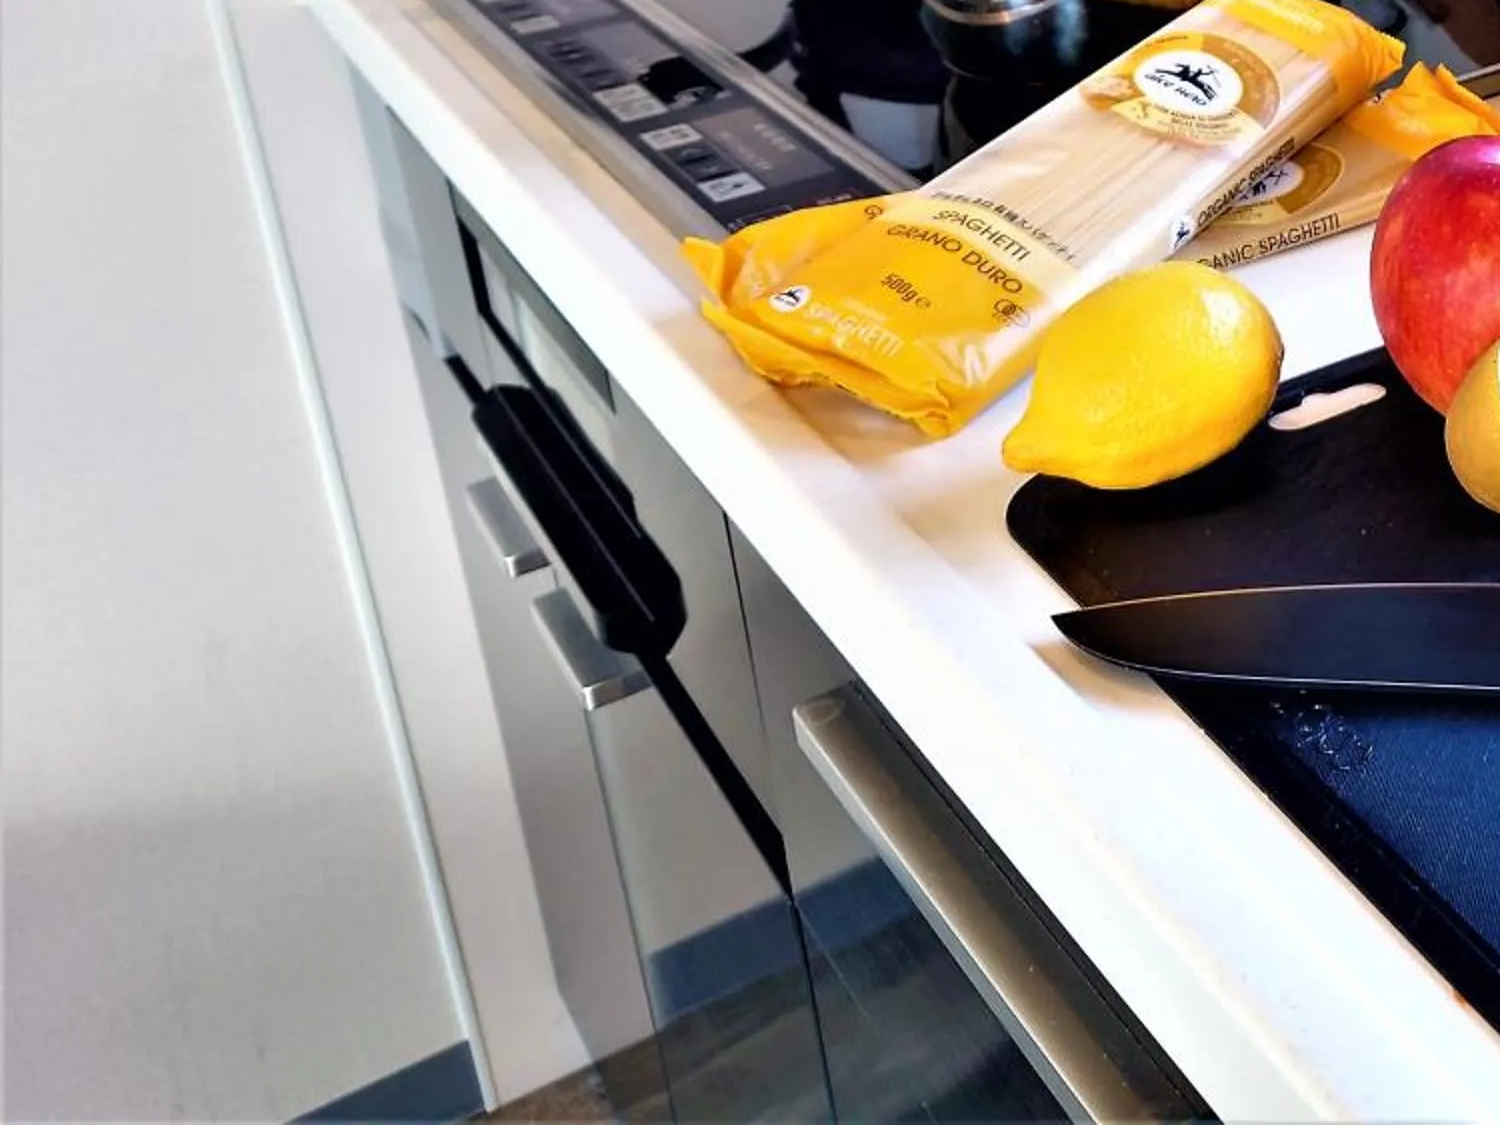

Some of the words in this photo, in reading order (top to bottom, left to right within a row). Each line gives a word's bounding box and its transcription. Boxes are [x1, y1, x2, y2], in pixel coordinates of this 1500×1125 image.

[887, 224, 962, 254] GRANO
[961, 250, 1024, 295] DURO
[933, 210, 1032, 262] SPAGHETTI
[1259, 213, 1340, 254] SPAGHETTI
